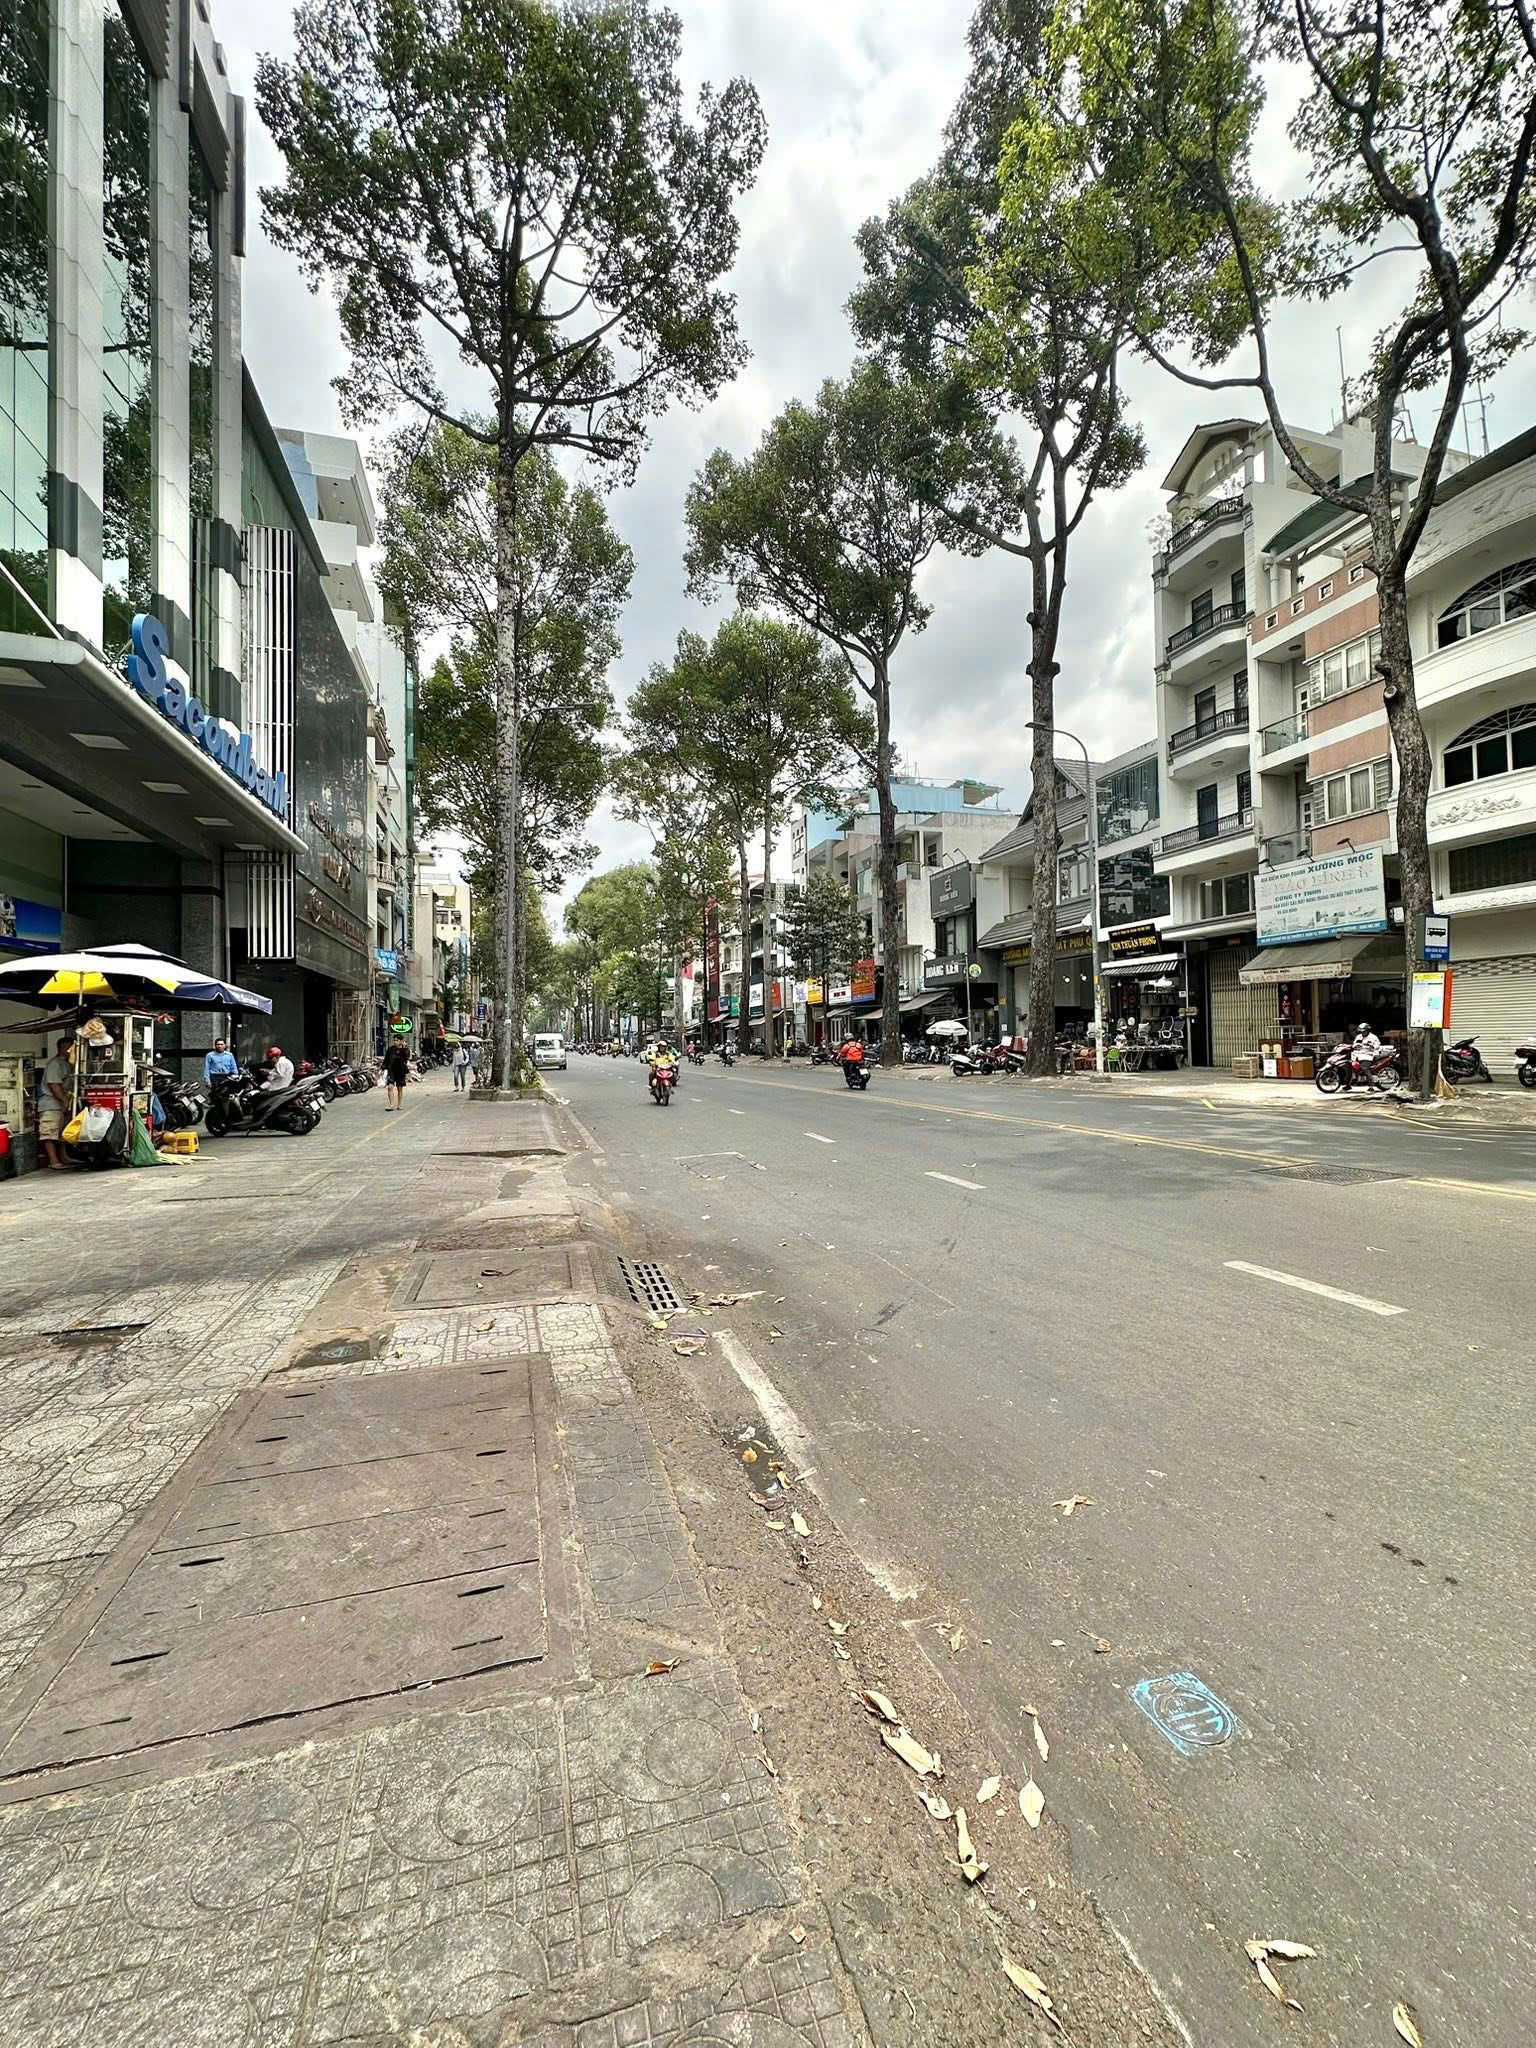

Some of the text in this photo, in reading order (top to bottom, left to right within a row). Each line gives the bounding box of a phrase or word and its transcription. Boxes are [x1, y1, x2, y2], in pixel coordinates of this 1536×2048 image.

[128, 614, 290, 820] Sacombank
[1307, 861, 1344, 873] XƯỞNG
[1347, 853, 1374, 864] MỘC
